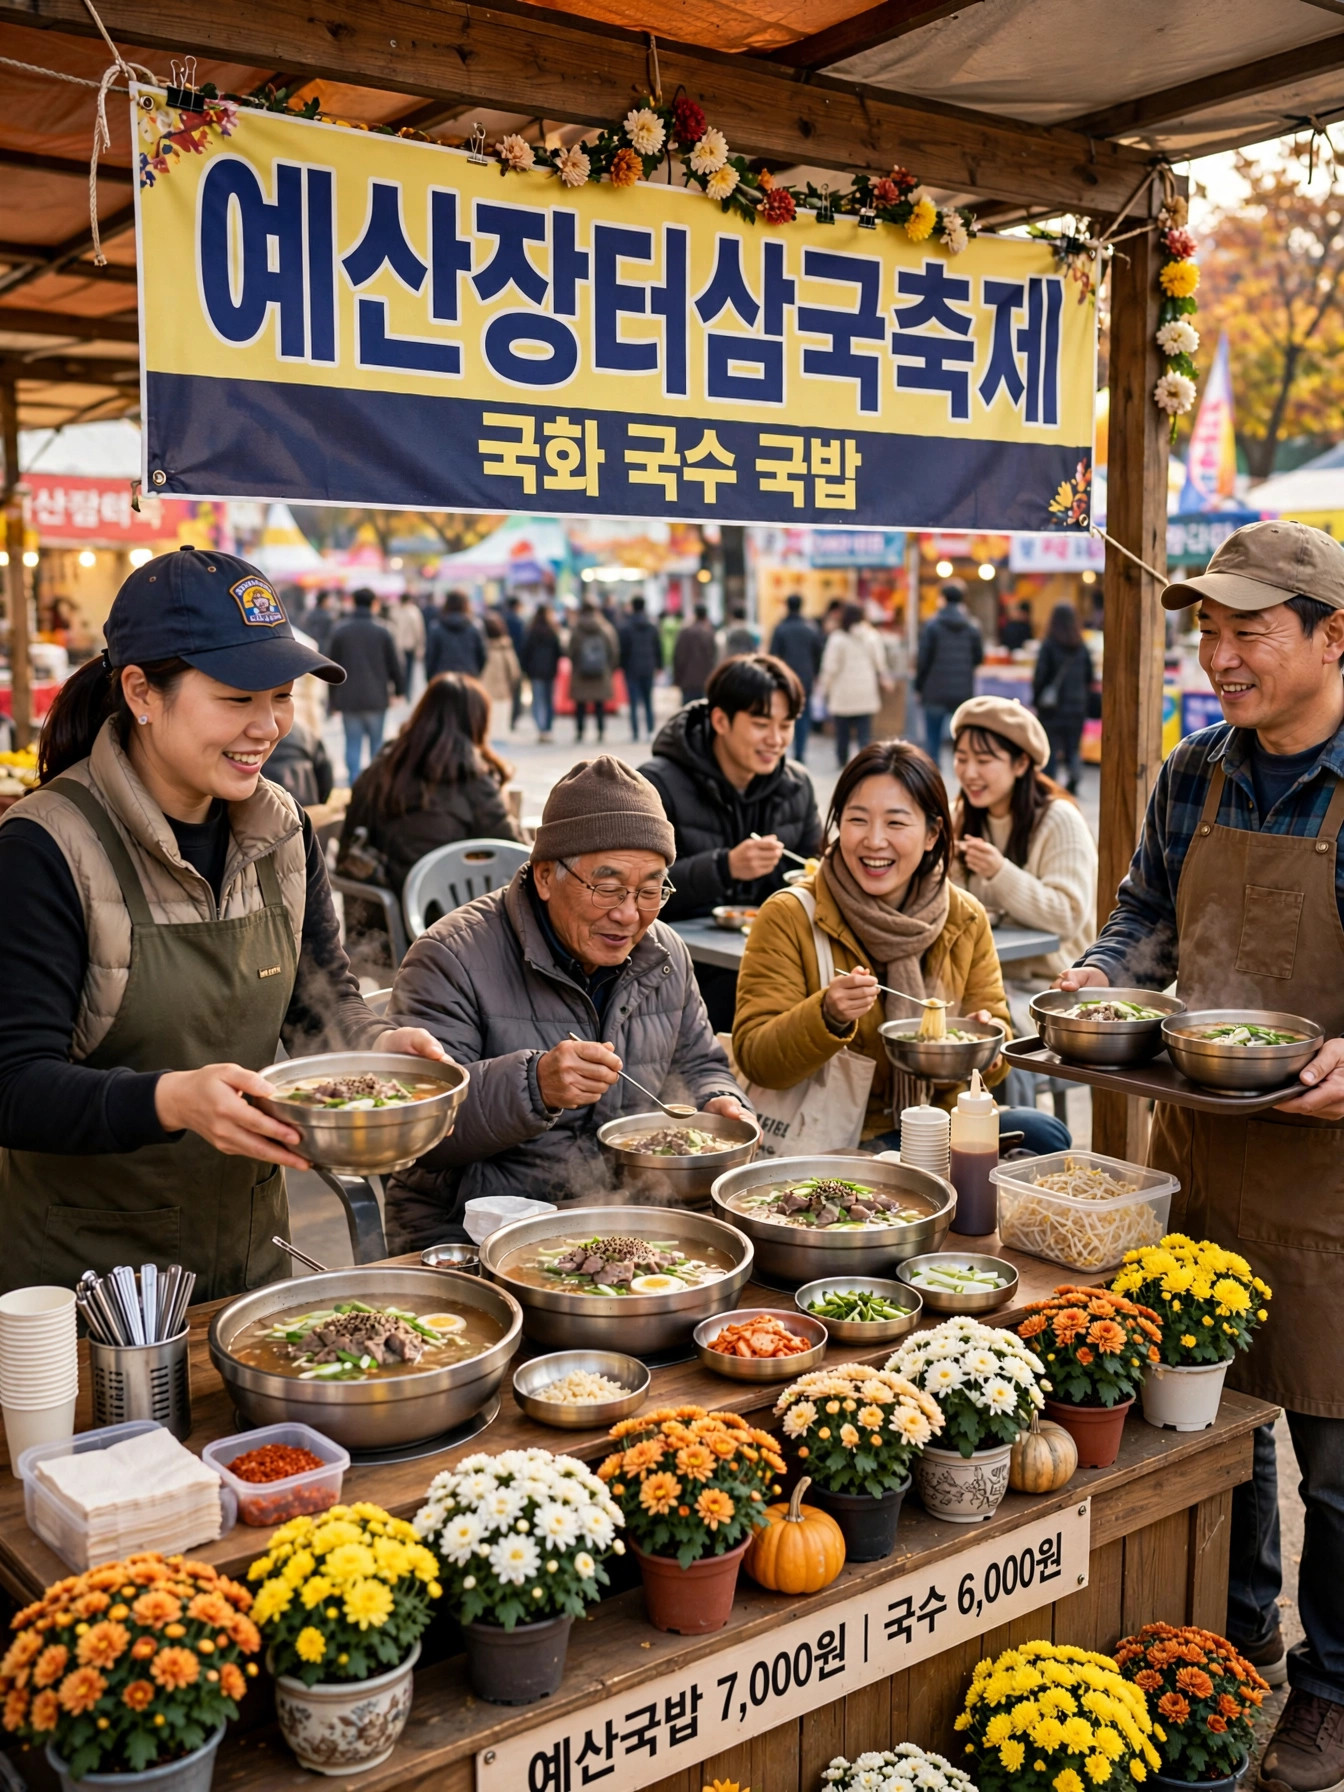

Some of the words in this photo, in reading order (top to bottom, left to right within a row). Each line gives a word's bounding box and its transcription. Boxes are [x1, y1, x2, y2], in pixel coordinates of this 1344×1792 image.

[199, 154, 1064, 426] 예산장터삼국축제
[478, 411, 605, 497] 국화
[624, 422, 738, 504] 국수
[754, 432, 862, 510] 국밥
[527, 1685, 704, 1792] 예산국밥
[716, 1620, 847, 1723] 7,000원
[882, 1585, 947, 1645] 국수
[957, 1531, 1063, 1618] 6,000원
